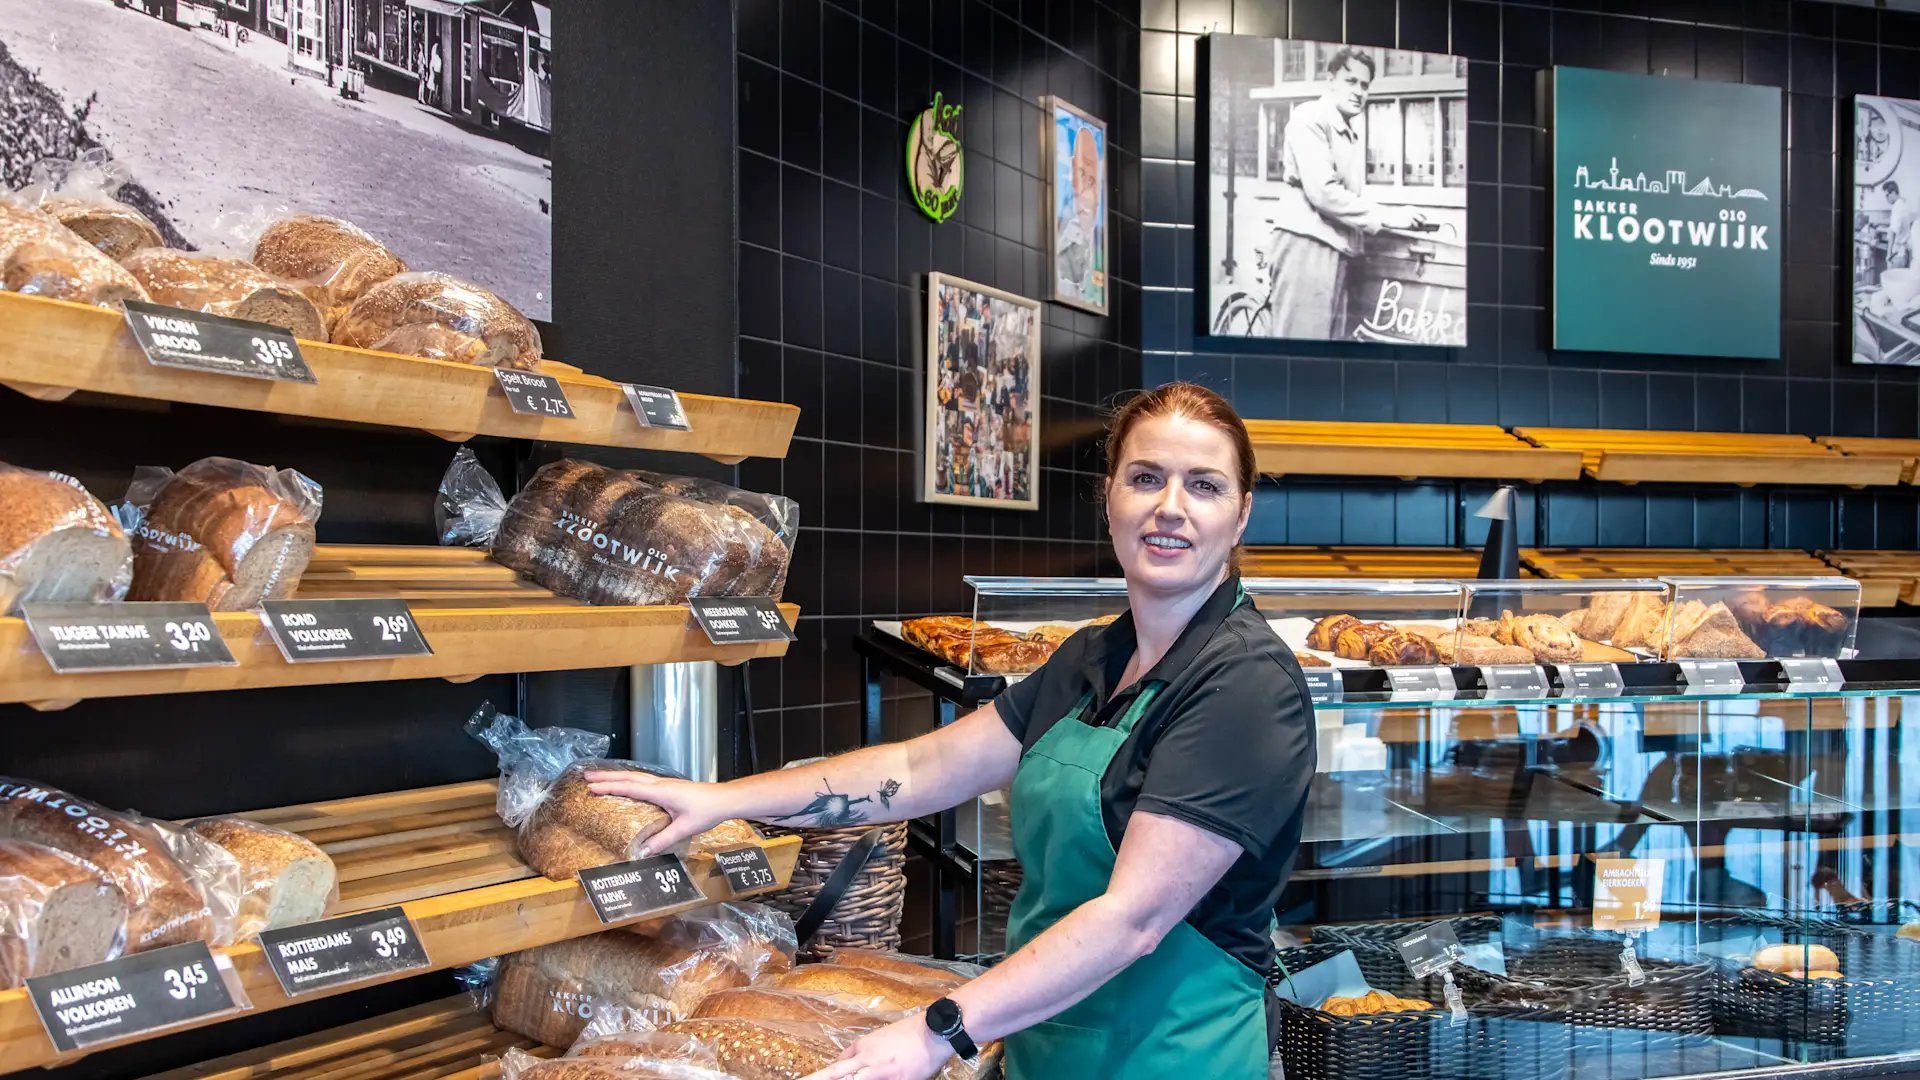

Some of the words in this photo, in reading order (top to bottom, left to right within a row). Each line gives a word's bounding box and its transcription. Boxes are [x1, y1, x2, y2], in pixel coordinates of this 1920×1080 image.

[1574, 199, 1638, 215] BAKKER
[1719, 209, 1747, 222] 010
[1574, 213, 1769, 250] KLOOTWIJK
[1649, 253, 1675, 266] Sinds
[1677, 256, 1697, 269] 1951
[143, 315, 199, 336] VIKORN
[151, 333, 202, 352] BROOD
[500, 371, 523, 384] Spelt
[521, 375, 547, 388] Brood
[527, 395, 537, 410] €
[541, 397, 568, 415] 2,75
[562, 510, 598, 529] BAKKER
[552, 517, 680, 583] KLOOTWIJK
[648, 547, 668, 561] 010
[280, 613, 317, 627] ROND
[702, 607, 748, 617] MEERGRANEN
[756, 610, 780, 630] 3,55
[49, 626, 99, 641] TIJGER
[98, 625, 150, 640] TARWE
[373, 615, 408, 642] 2,69
[709, 620, 739, 629] DONKER
[165, 622, 211, 652] 3,20
[288, 628, 353, 643] VOLKOREN
[720, 855, 743, 866] Desem
[740, 850, 758, 863] Spelt
[591, 872, 642, 891] ROTTERDAMS
[655, 868, 681, 893] 3,49
[741, 872, 750, 886] €
[751, 868, 772, 886] 3,75
[1603, 878, 1646, 889] EIERKOEKEN
[598, 890, 627, 905] TARWE
[278, 931, 352, 958] ROTTERDAMS
[371, 926, 407, 958] 3,49
[1402, 934, 1427, 948] CROISSANT
[286, 957, 319, 975] MAIS
[164, 963, 208, 1000] 3,45
[50, 976, 121, 1007] ALLINSON
[56, 993, 137, 1025] VOLKOREN
